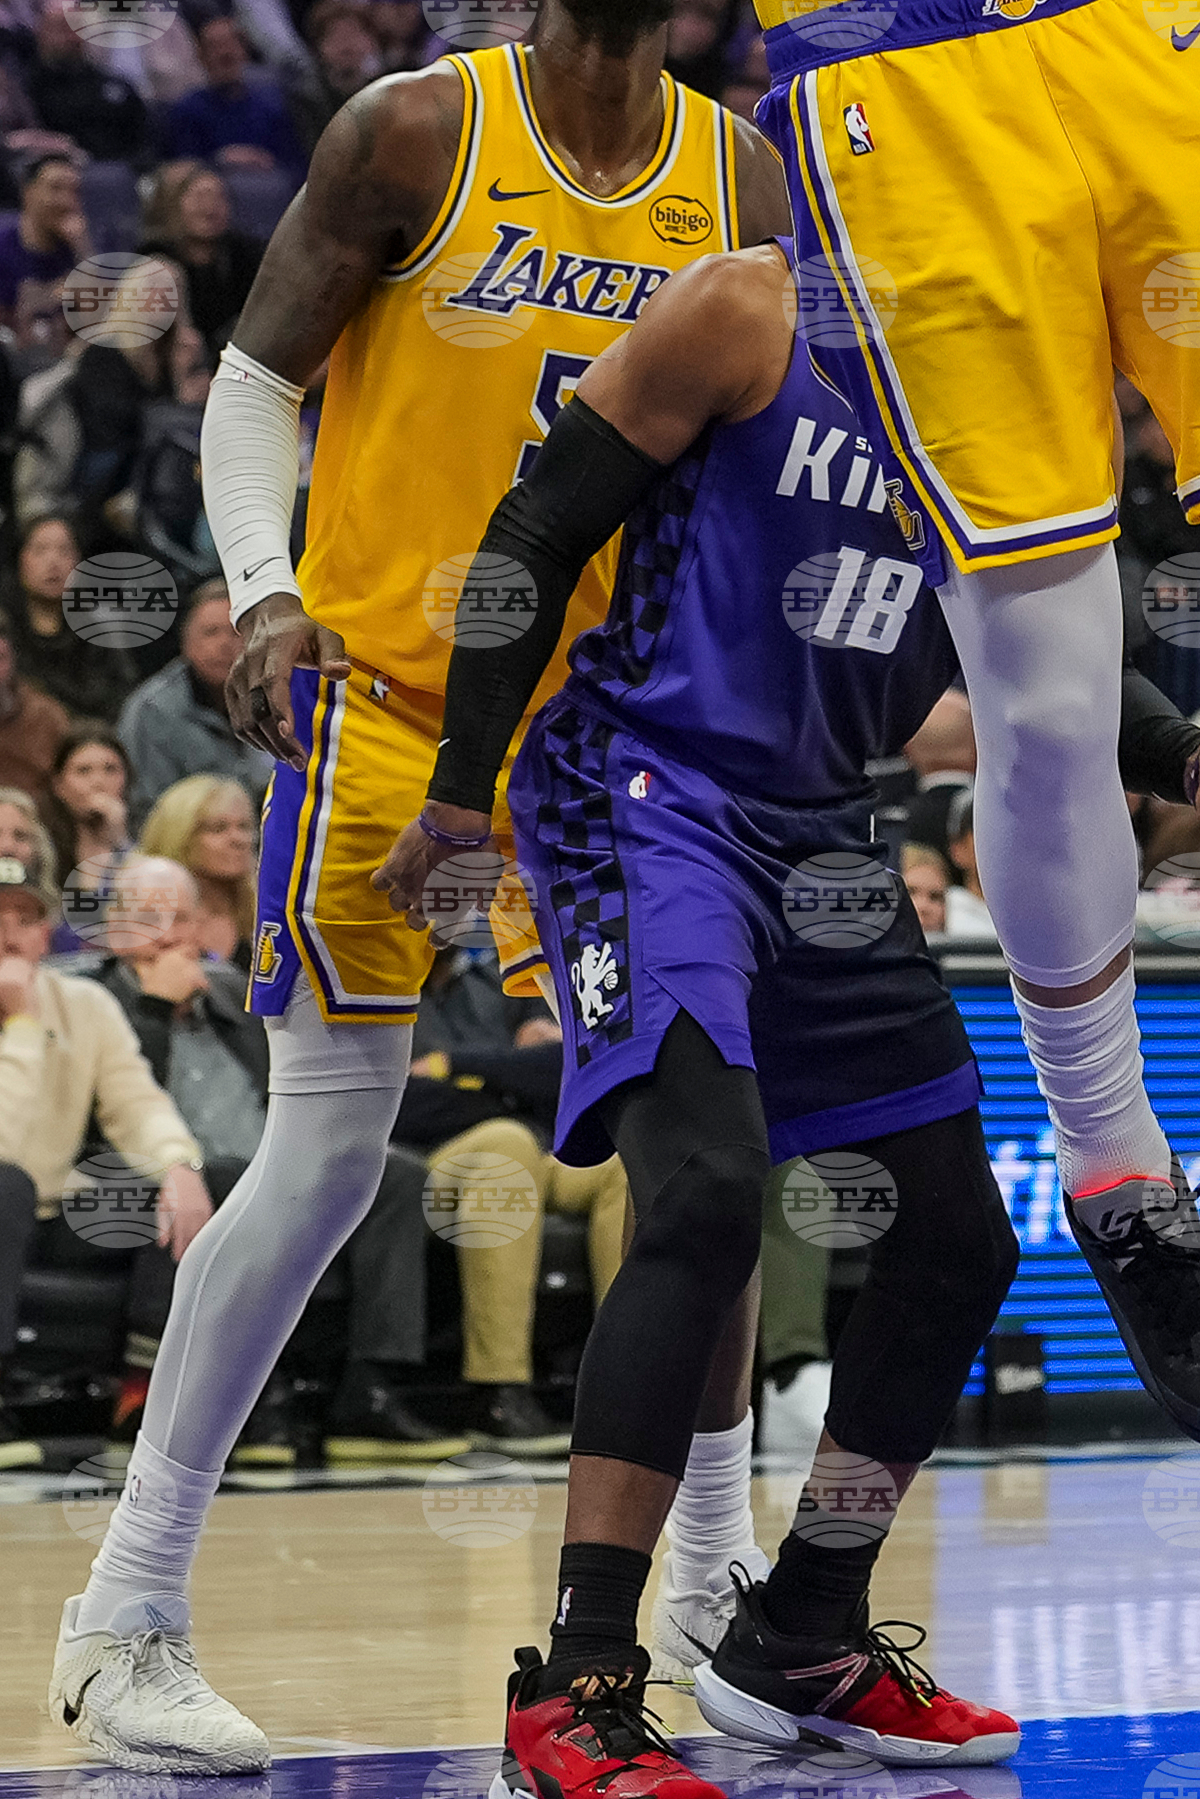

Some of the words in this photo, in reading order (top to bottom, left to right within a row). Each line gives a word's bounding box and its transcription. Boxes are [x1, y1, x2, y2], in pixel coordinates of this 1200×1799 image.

[656, 206, 708, 232] bibigo
[441, 220, 675, 325] LAKER
[813, 545, 924, 655] 18
